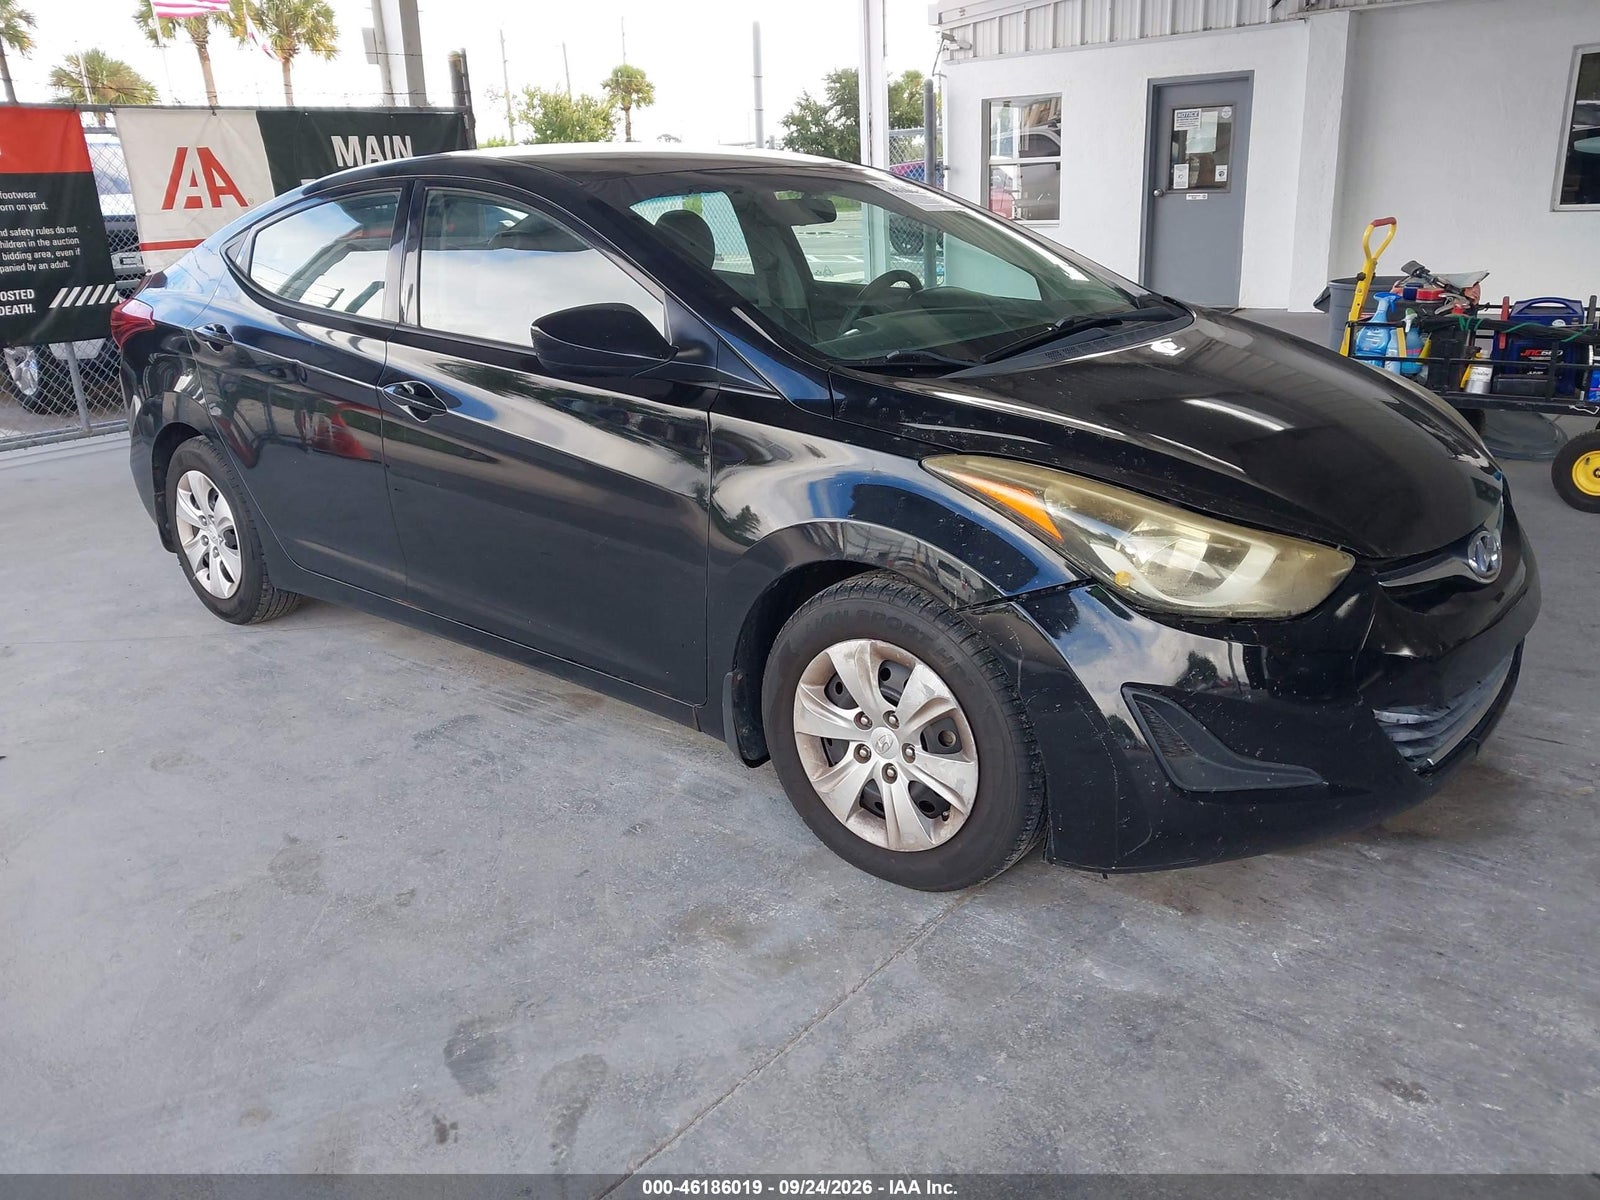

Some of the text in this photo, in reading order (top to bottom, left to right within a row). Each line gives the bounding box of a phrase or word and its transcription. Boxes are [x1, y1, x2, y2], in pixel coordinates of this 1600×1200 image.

[330, 135, 413, 167] MAIN
[28, 202, 48, 212] yard.
[9, 227, 34, 237] safety
[36, 226, 55, 235] rules
[55, 226, 66, 234] do
[66, 225, 78, 233] not
[28, 239, 36, 247] in
[37, 238, 50, 246] the
[52, 237, 80, 246] auction
[2, 247, 81, 261] bidding area, even if
[27, 262, 37, 272] by
[50, 260, 71, 269] adult.
[0, 303, 36, 316] DEATH.
[855, 609, 936, 644] SPORT
